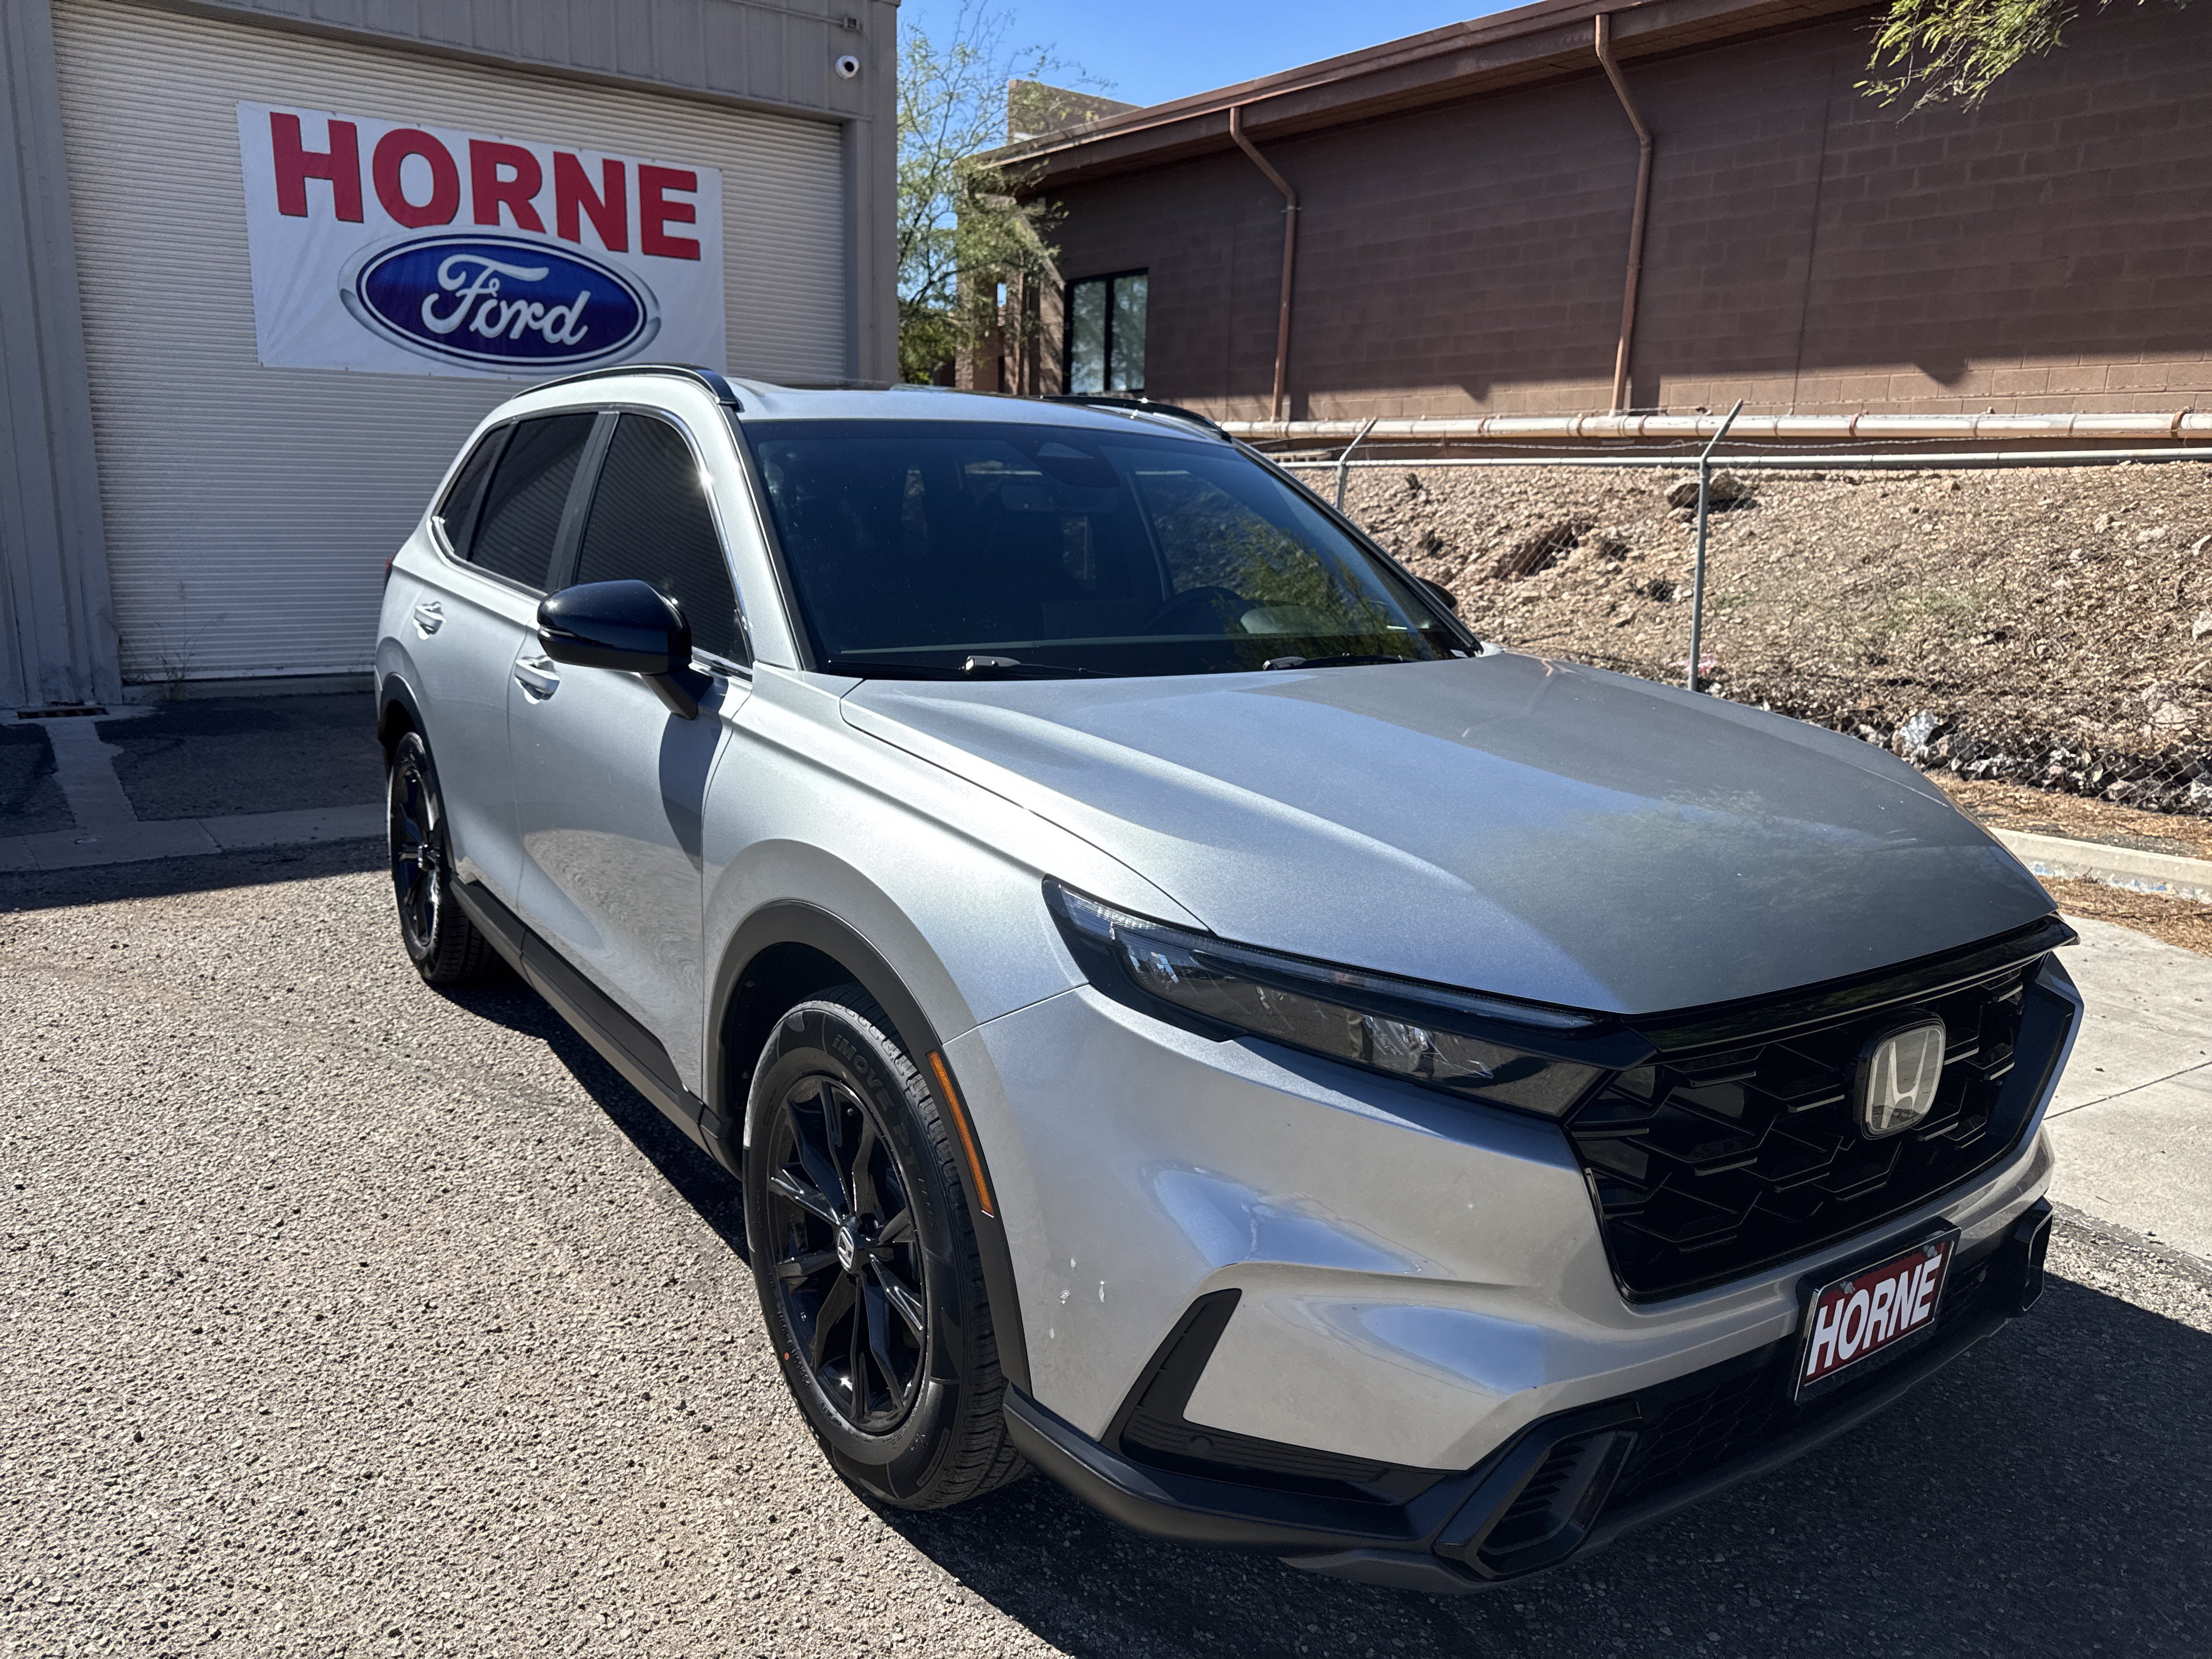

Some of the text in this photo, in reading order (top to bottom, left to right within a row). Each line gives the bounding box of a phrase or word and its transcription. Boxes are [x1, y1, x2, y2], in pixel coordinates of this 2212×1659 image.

[269, 111, 701, 261] HORNE
[421, 254, 591, 346] Ford
[1806, 1254, 1943, 1377] HORNE
